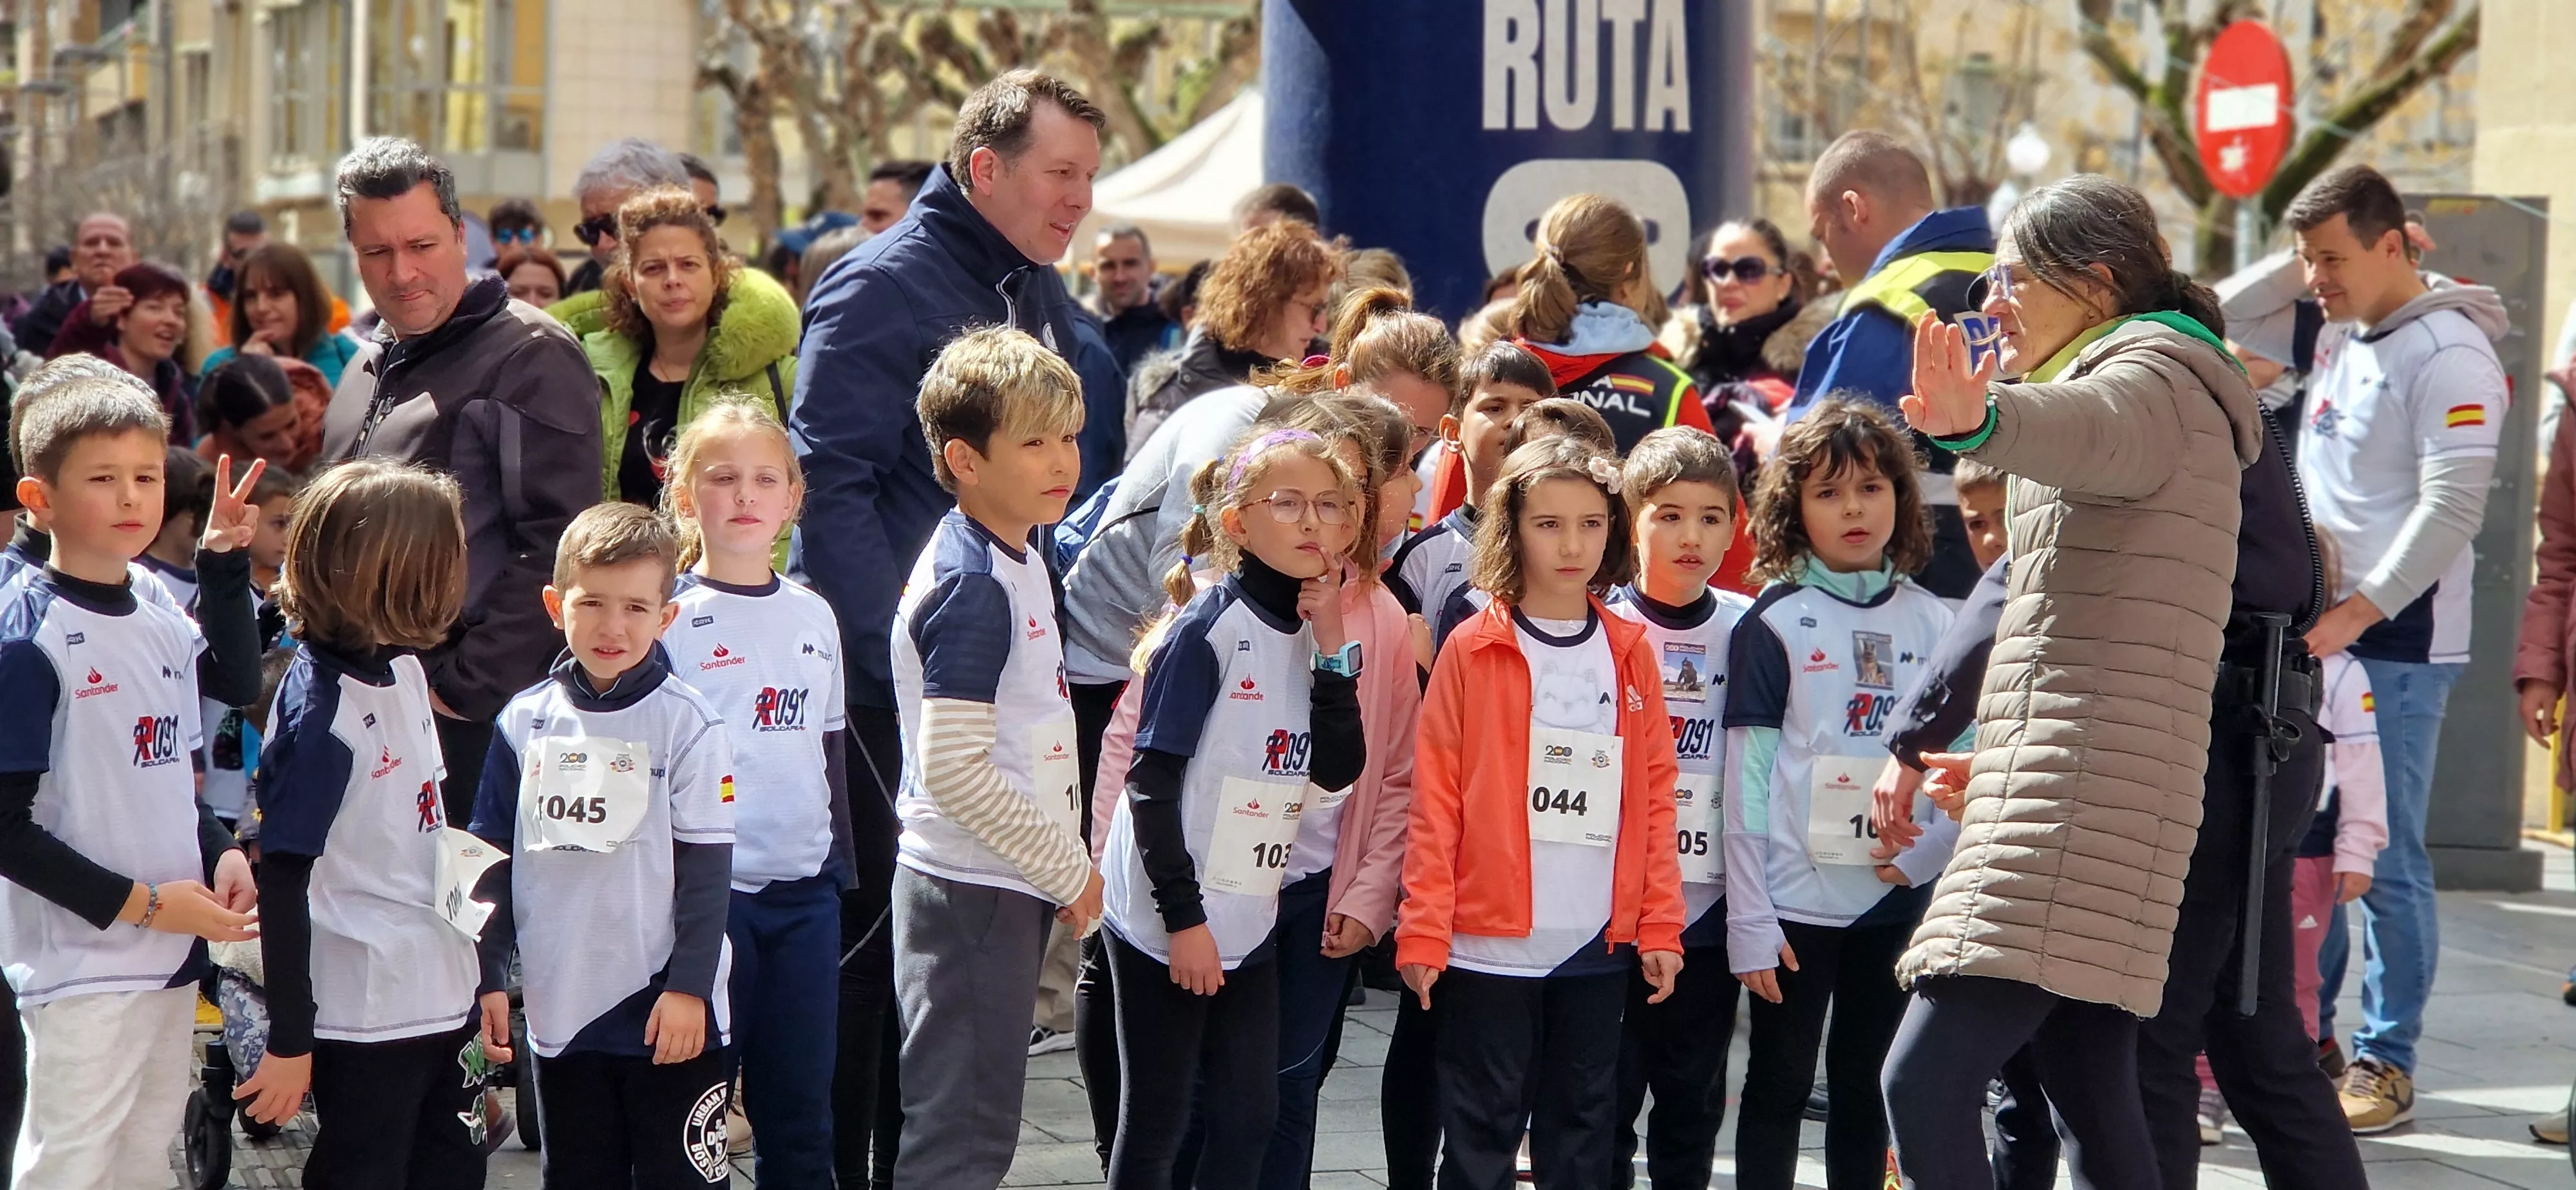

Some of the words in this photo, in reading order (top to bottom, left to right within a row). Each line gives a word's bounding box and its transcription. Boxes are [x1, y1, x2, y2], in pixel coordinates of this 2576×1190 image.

[1482, 0, 1690, 131] RUTA
[700, 657, 746, 671] Santander
[75, 683, 119, 699] Santander
[1262, 729, 1311, 772] R09
[1824, 782, 1862, 791] Santander
[1233, 807, 1270, 819] Santander
[691, 1092, 721, 1127] URBAN
